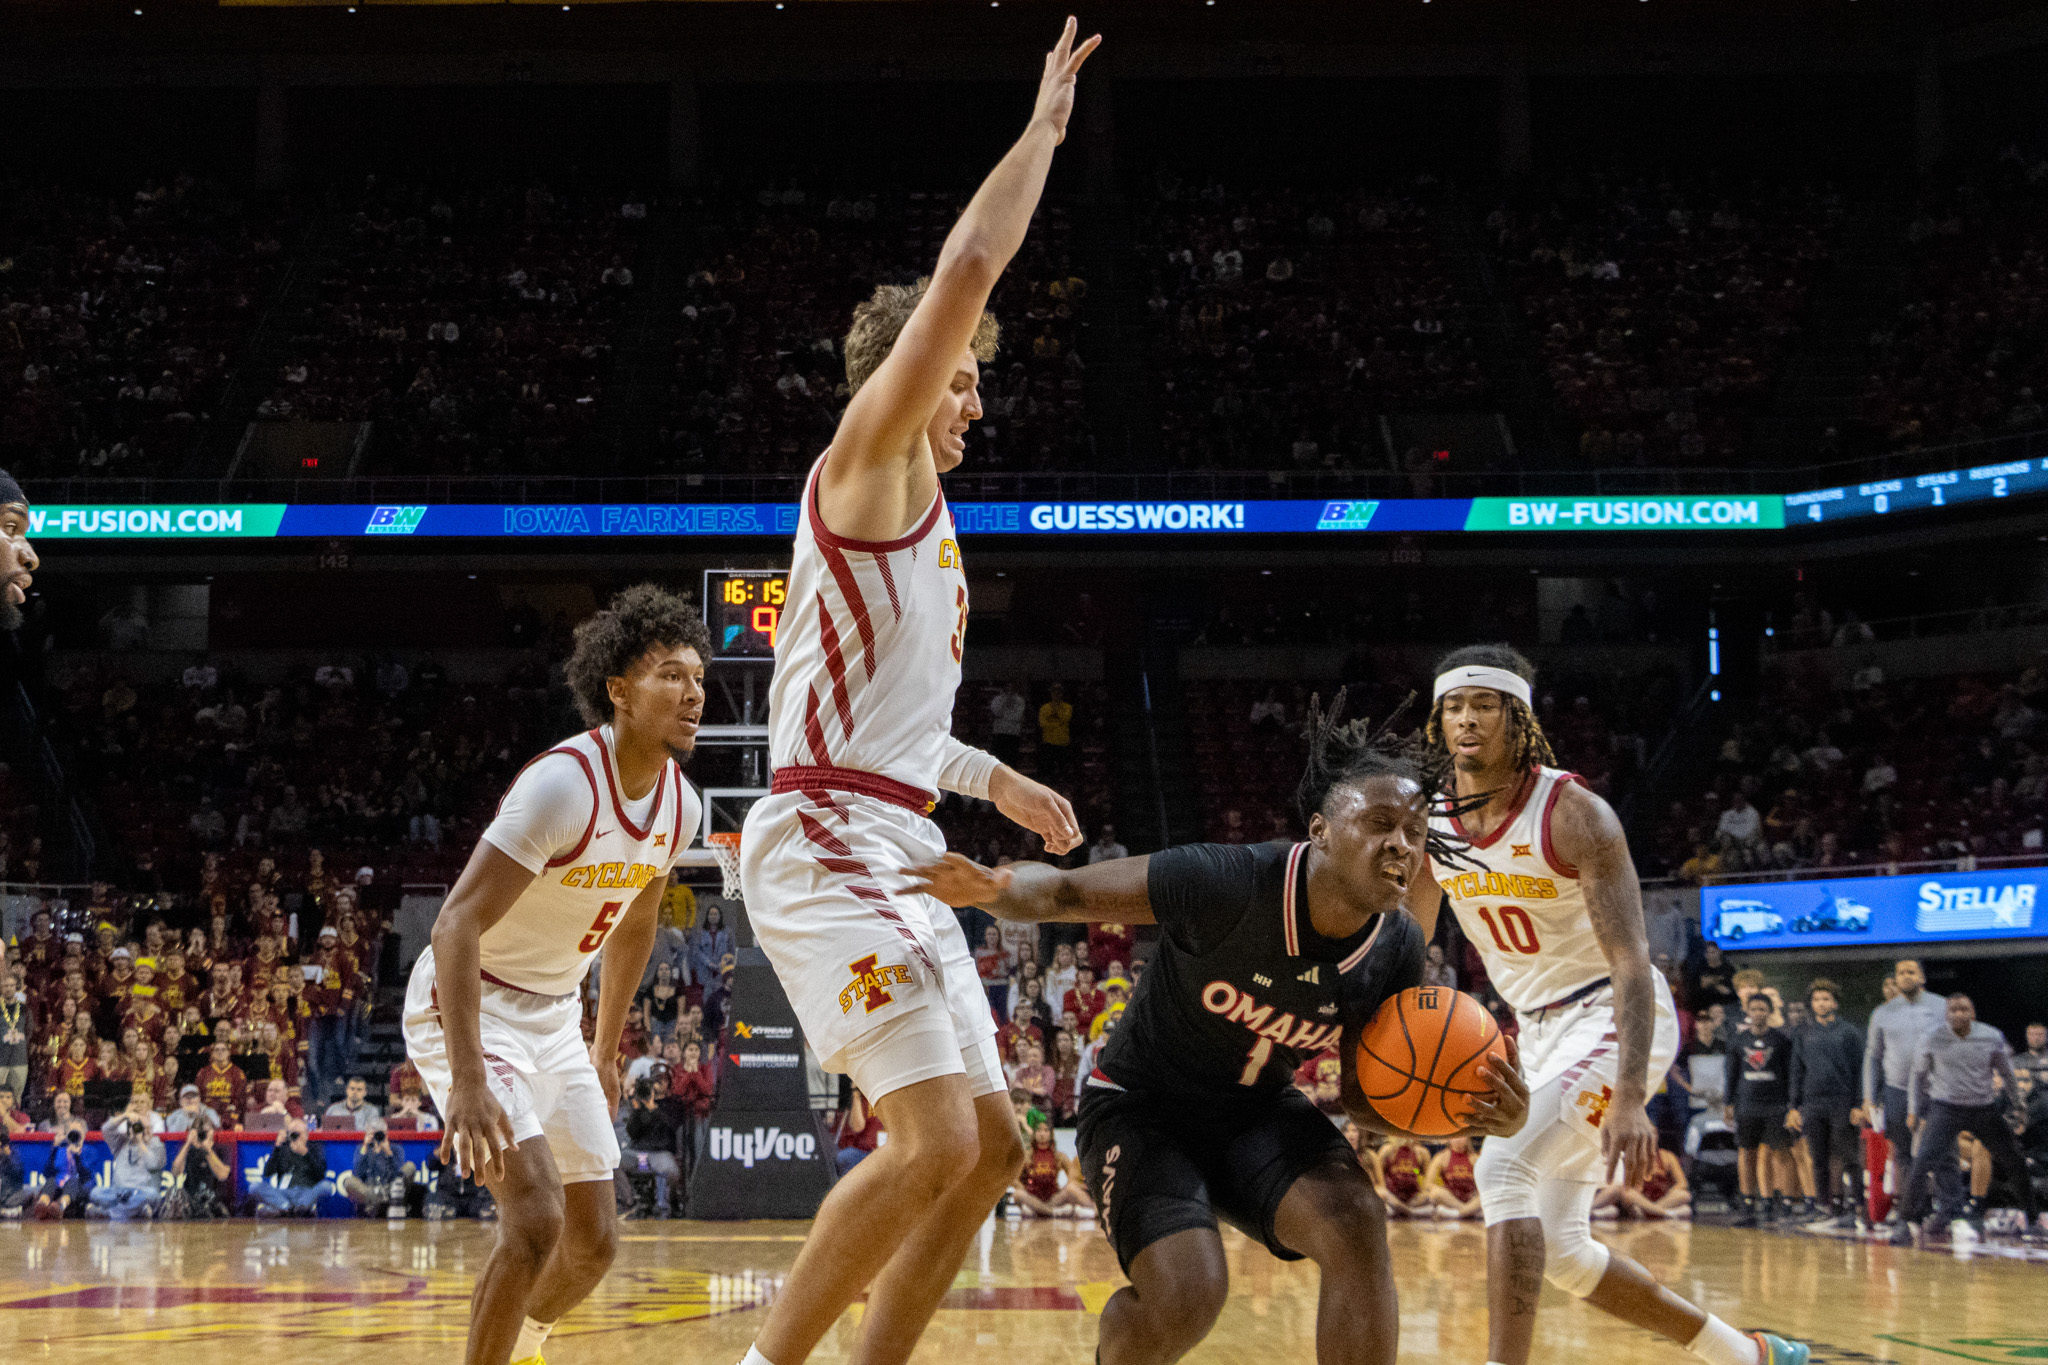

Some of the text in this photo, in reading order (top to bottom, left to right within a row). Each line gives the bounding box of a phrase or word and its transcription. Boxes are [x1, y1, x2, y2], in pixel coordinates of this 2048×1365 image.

[1858, 479, 1903, 496] BLOCKS
[1916, 471, 1959, 488] STEALS
[1993, 477, 2009, 498] 2
[1873, 493, 1889, 513] 0
[1931, 486, 1946, 506] 1
[27, 509, 243, 533] W-FUSION.COM
[369, 505, 428, 527] BW
[503, 507, 590, 533] IOWA
[602, 506, 763, 532] FARMERS.
[954, 502, 1245, 531] THE GUESSWORK!
[1320, 501, 1380, 523] BW
[1508, 501, 1759, 526] BW-FUSION.COM
[578, 901, 623, 954] 5
[1478, 905, 1541, 955] 10
[838, 964, 914, 1015] STATE
[1252, 972, 1273, 988] HH
[1201, 980, 1343, 1054] OMAHA
[1238, 1036, 1273, 1087] 1
